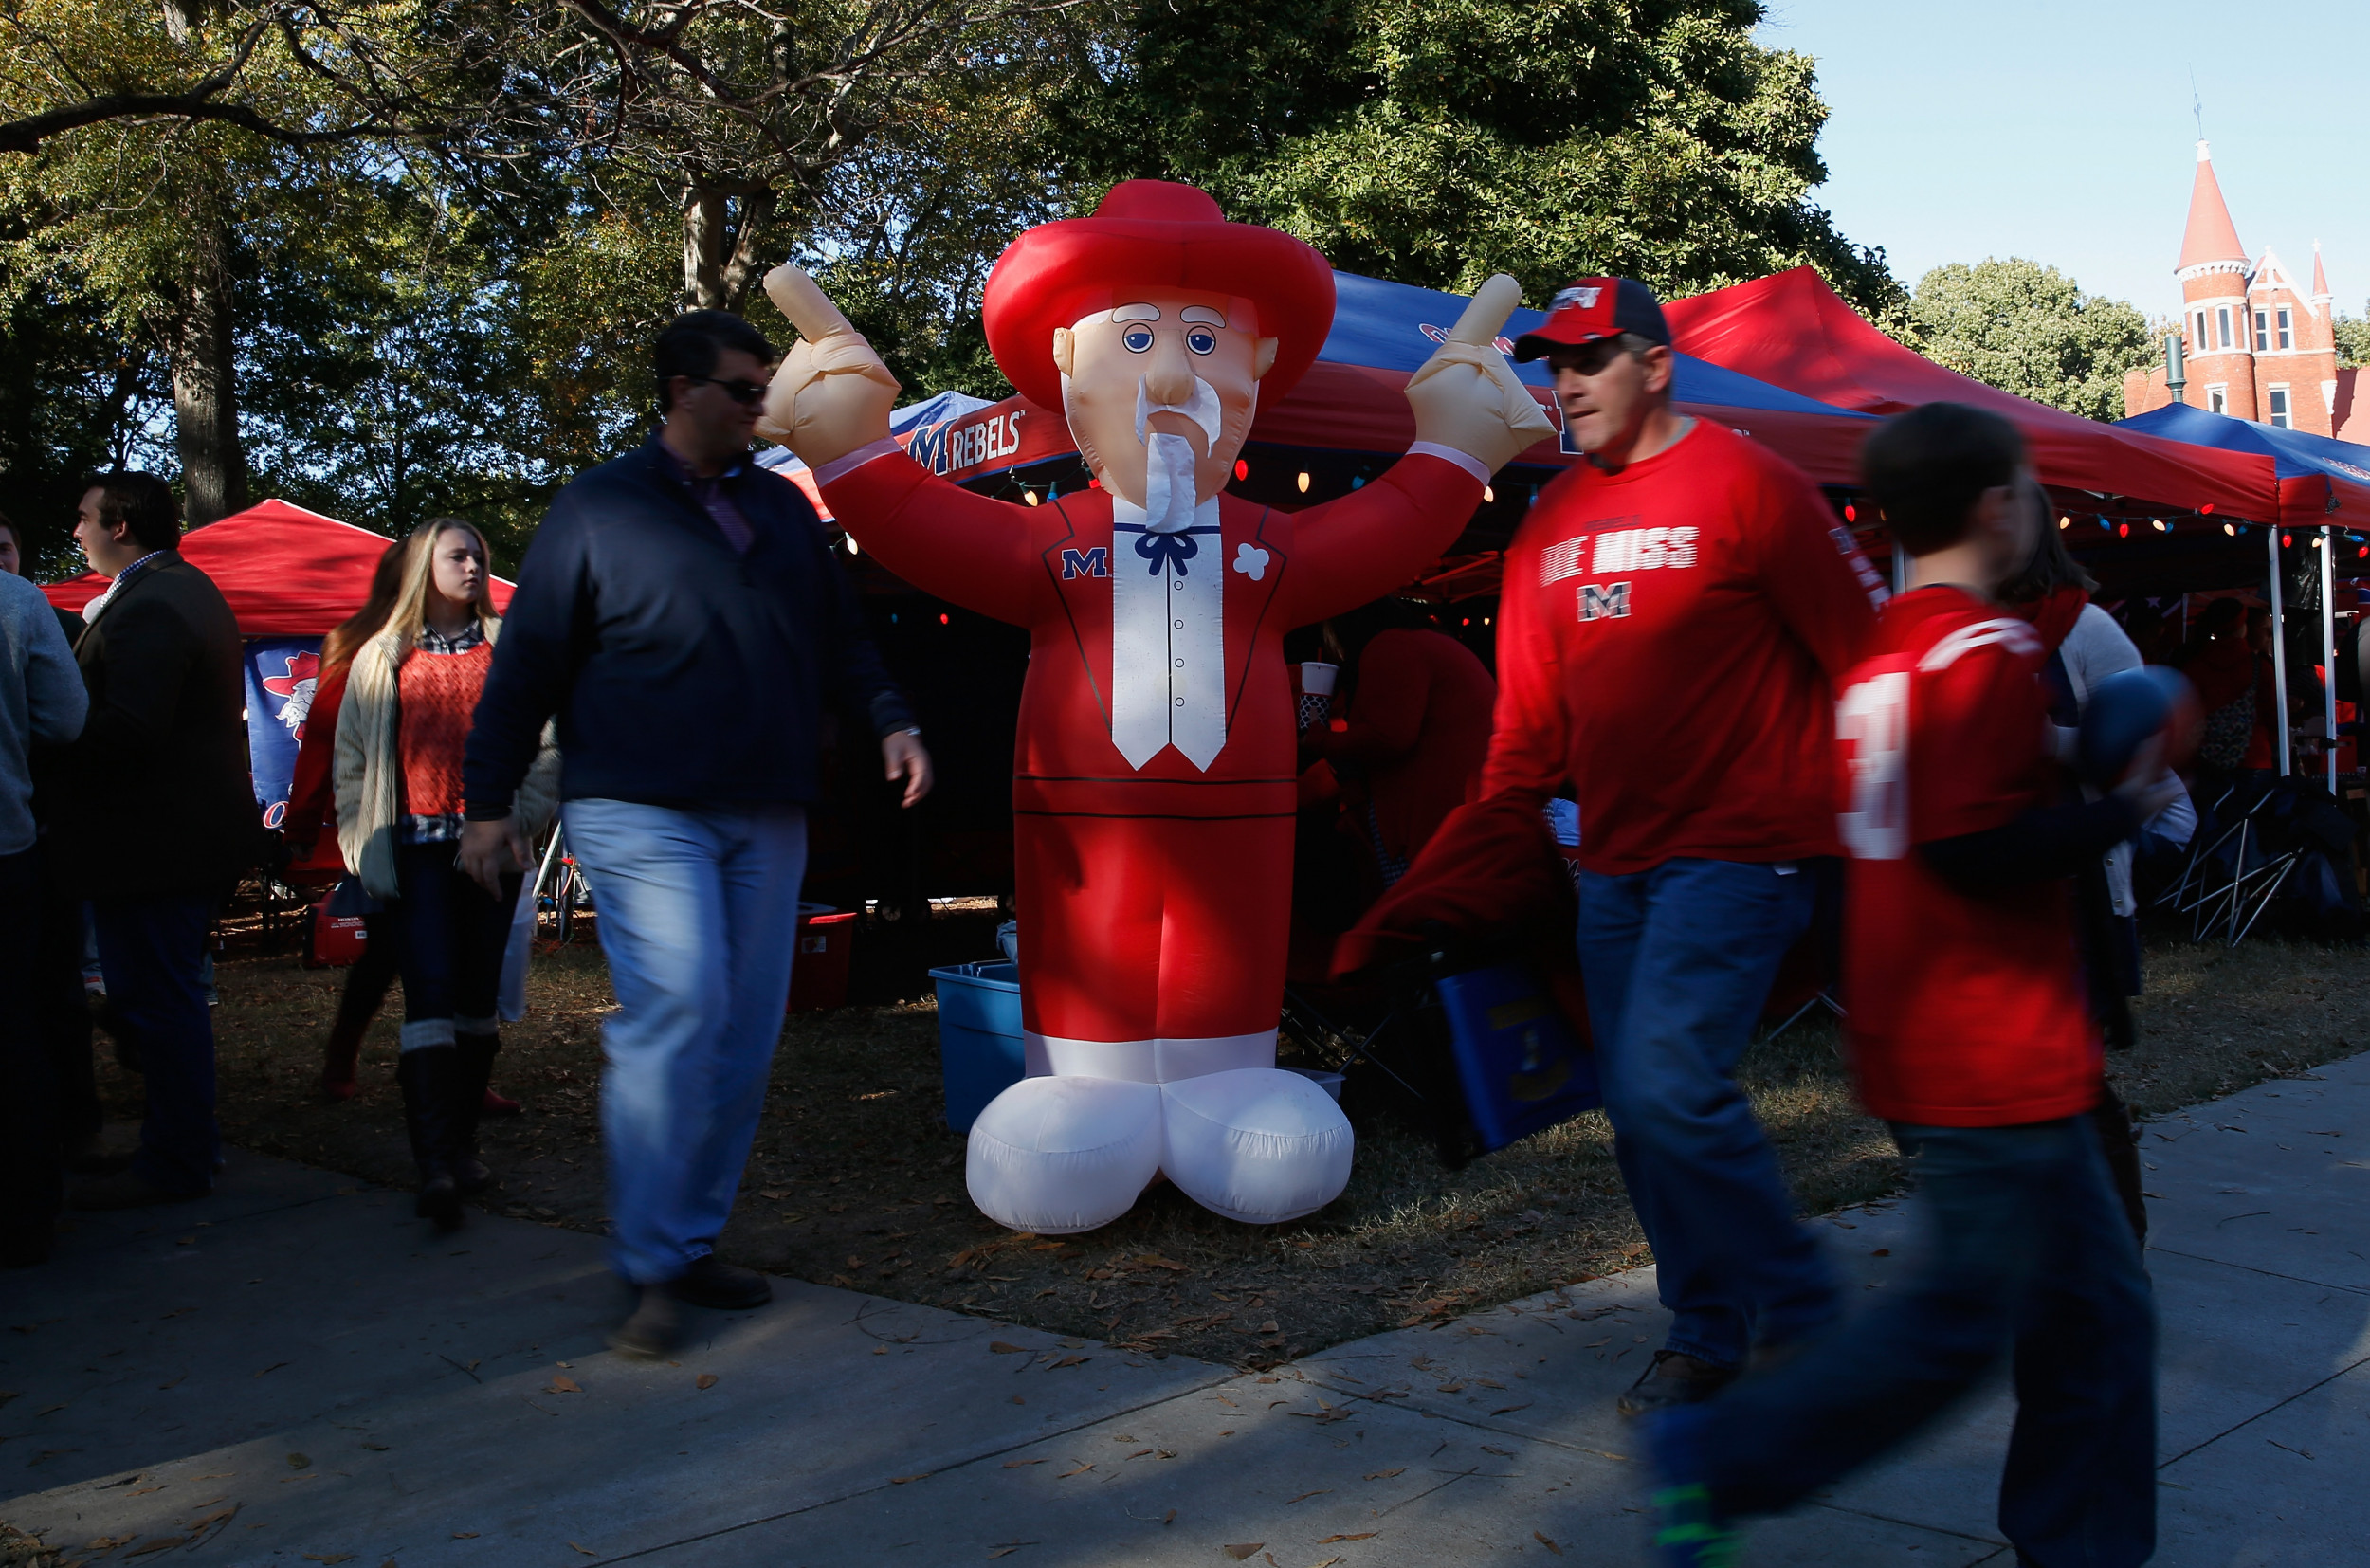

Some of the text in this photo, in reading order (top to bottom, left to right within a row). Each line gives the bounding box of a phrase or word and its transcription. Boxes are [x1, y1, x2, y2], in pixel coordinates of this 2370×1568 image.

[952, 410, 1021, 472] REBELS
[1061, 546, 1107, 580] M
[1576, 580, 1632, 623] M
